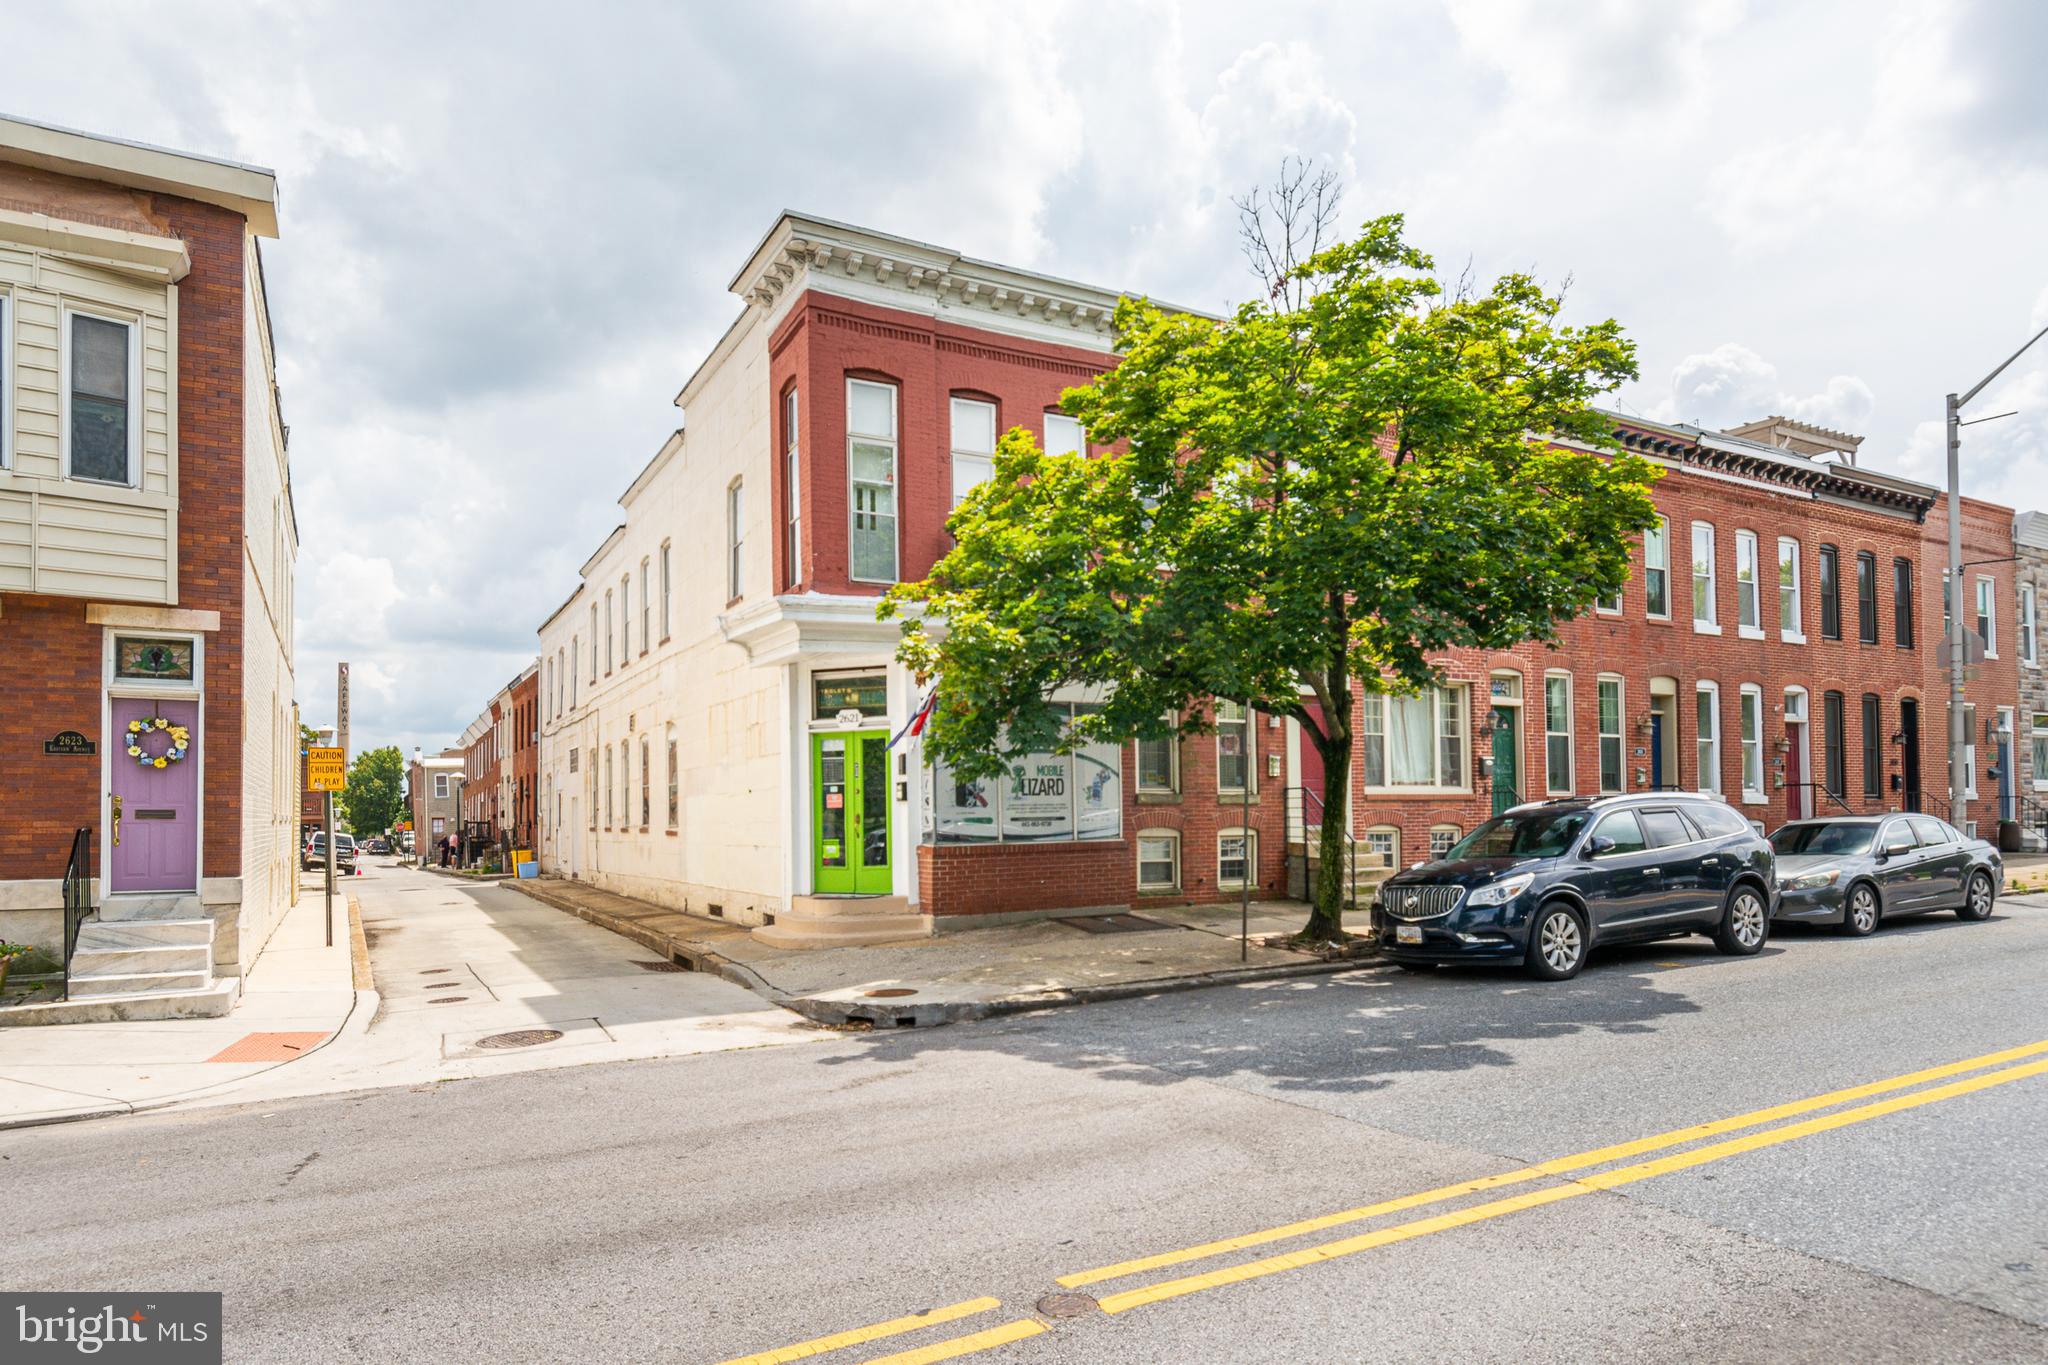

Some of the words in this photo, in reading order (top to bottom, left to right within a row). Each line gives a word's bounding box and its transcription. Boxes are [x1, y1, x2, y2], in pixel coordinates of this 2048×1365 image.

[341, 677, 349, 730] SAFEWAY
[838, 713, 859, 723] 2621
[59, 736, 82, 745] 2623
[310, 751, 342, 760] CAUTION
[310, 765, 343, 774] CHILDREN
[1036, 765, 1064, 776] MOBILE
[313, 777, 321, 786] AT
[324, 777, 340, 786] PLAY
[1021, 778, 1064, 796] LIZARD
